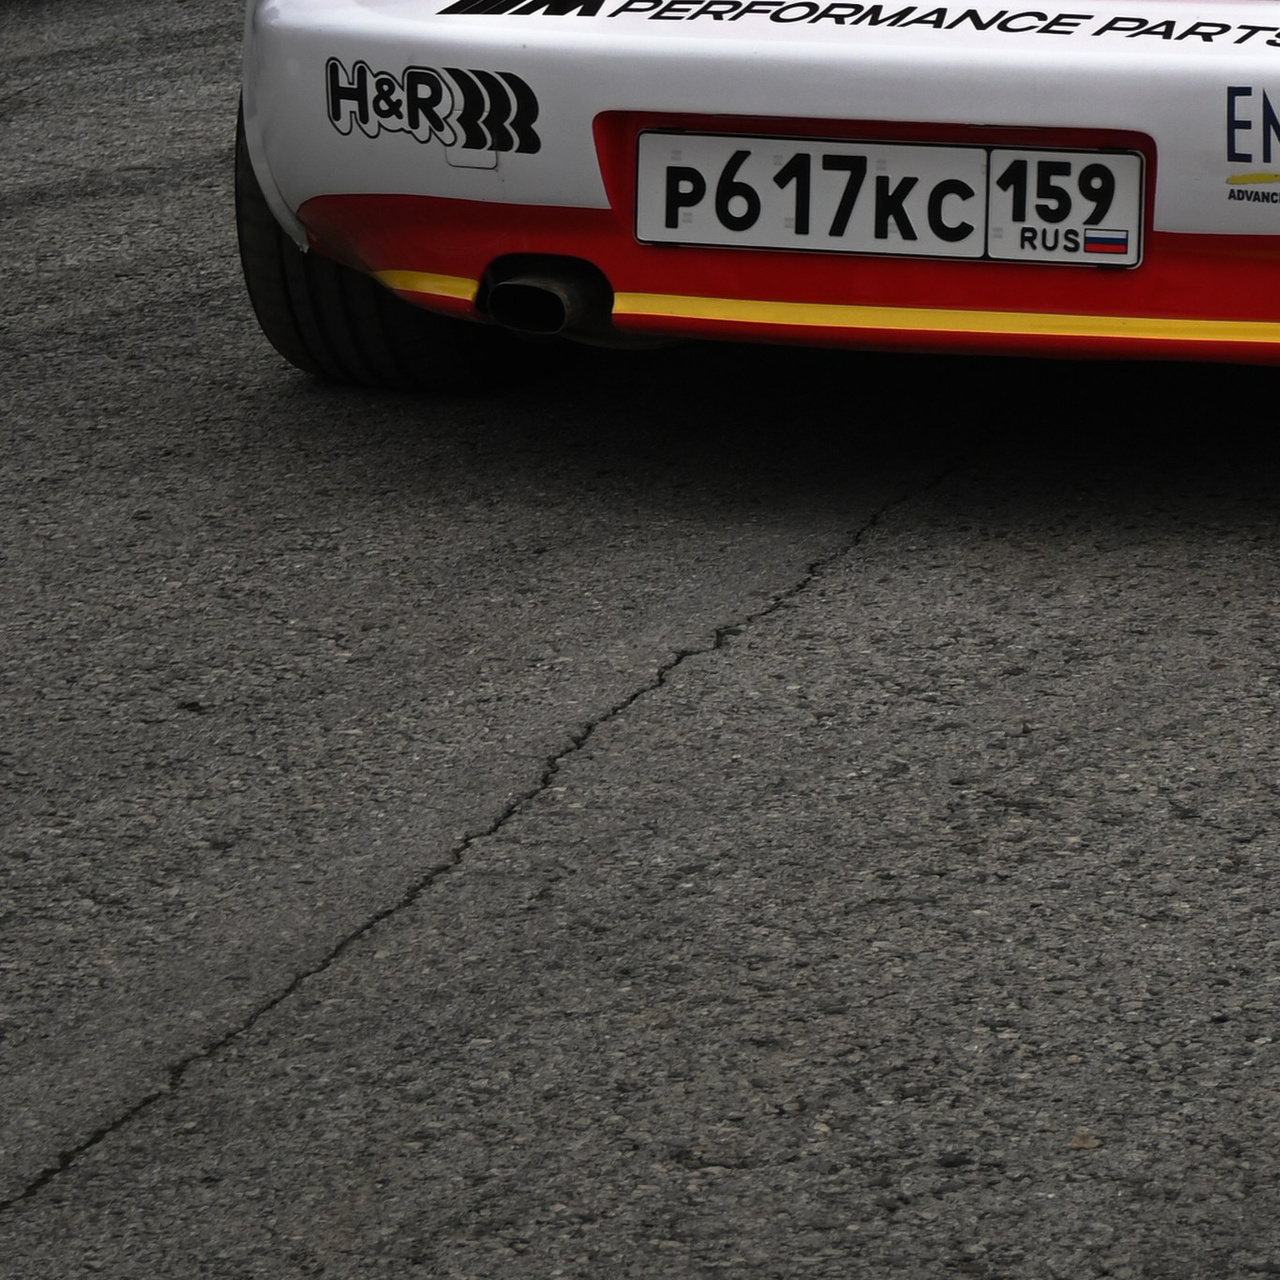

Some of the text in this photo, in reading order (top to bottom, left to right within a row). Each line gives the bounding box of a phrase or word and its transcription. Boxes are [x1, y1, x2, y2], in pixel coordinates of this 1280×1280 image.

[326, 57, 456, 146] H&R
[996, 158, 1117, 226] 159
[1020, 227, 1080, 253] RUS
